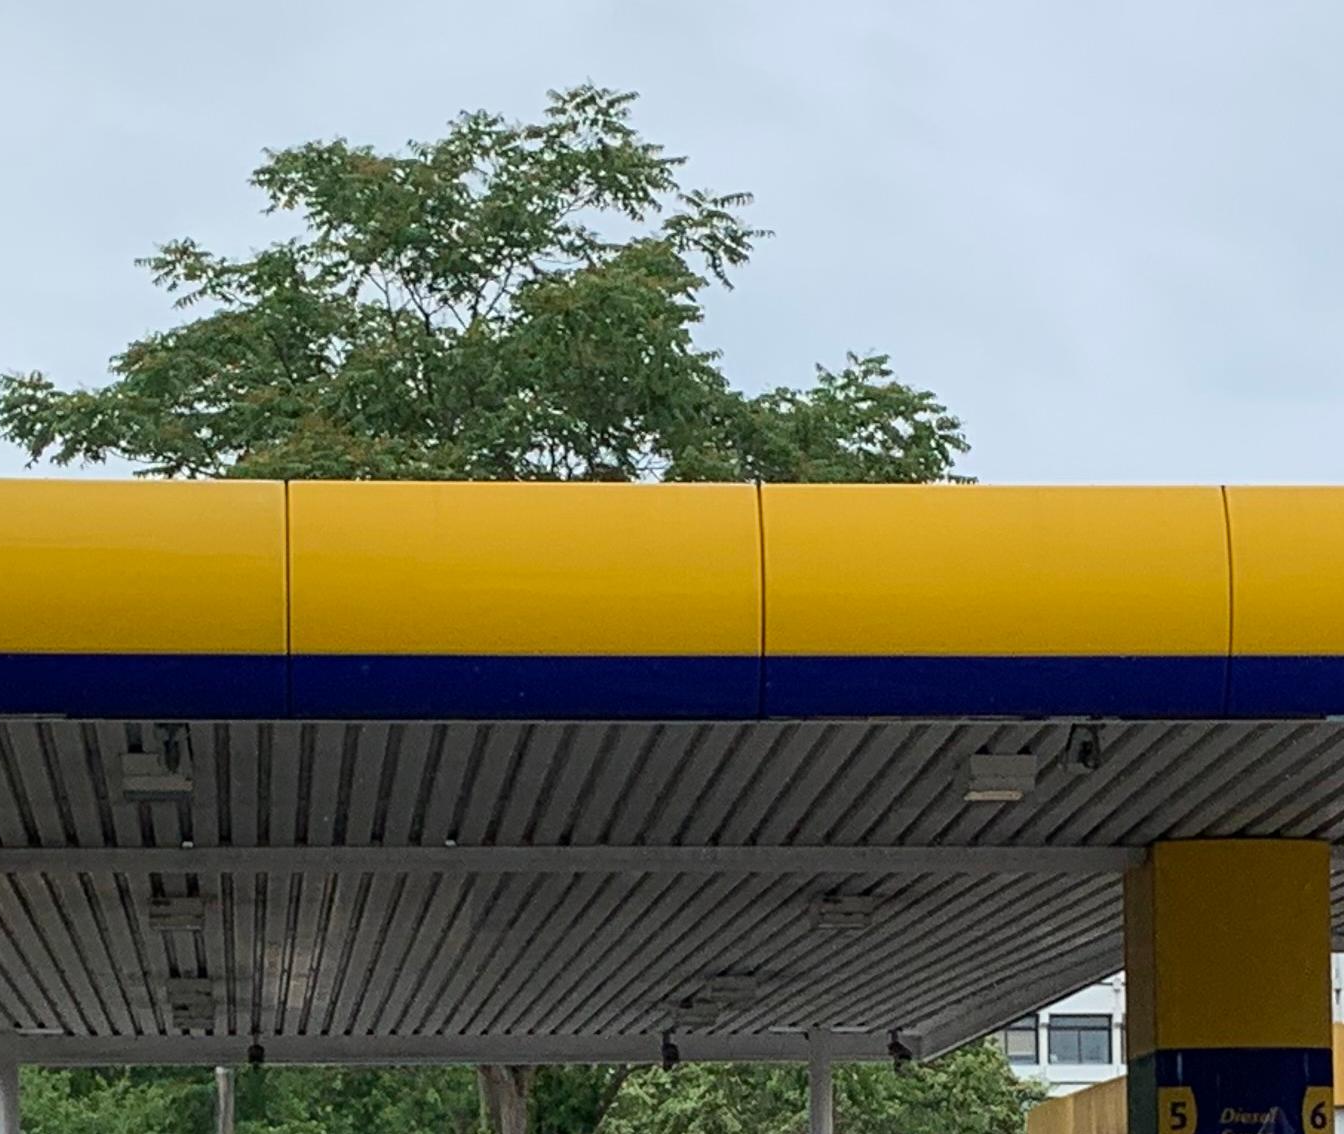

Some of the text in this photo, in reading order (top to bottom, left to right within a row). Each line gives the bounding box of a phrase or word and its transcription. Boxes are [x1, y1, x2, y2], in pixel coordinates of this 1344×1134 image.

[1170, 1101, 1188, 1131] 5
[1219, 1106, 1279, 1125] Diesel
[1310, 1101, 1327, 1130] 6
